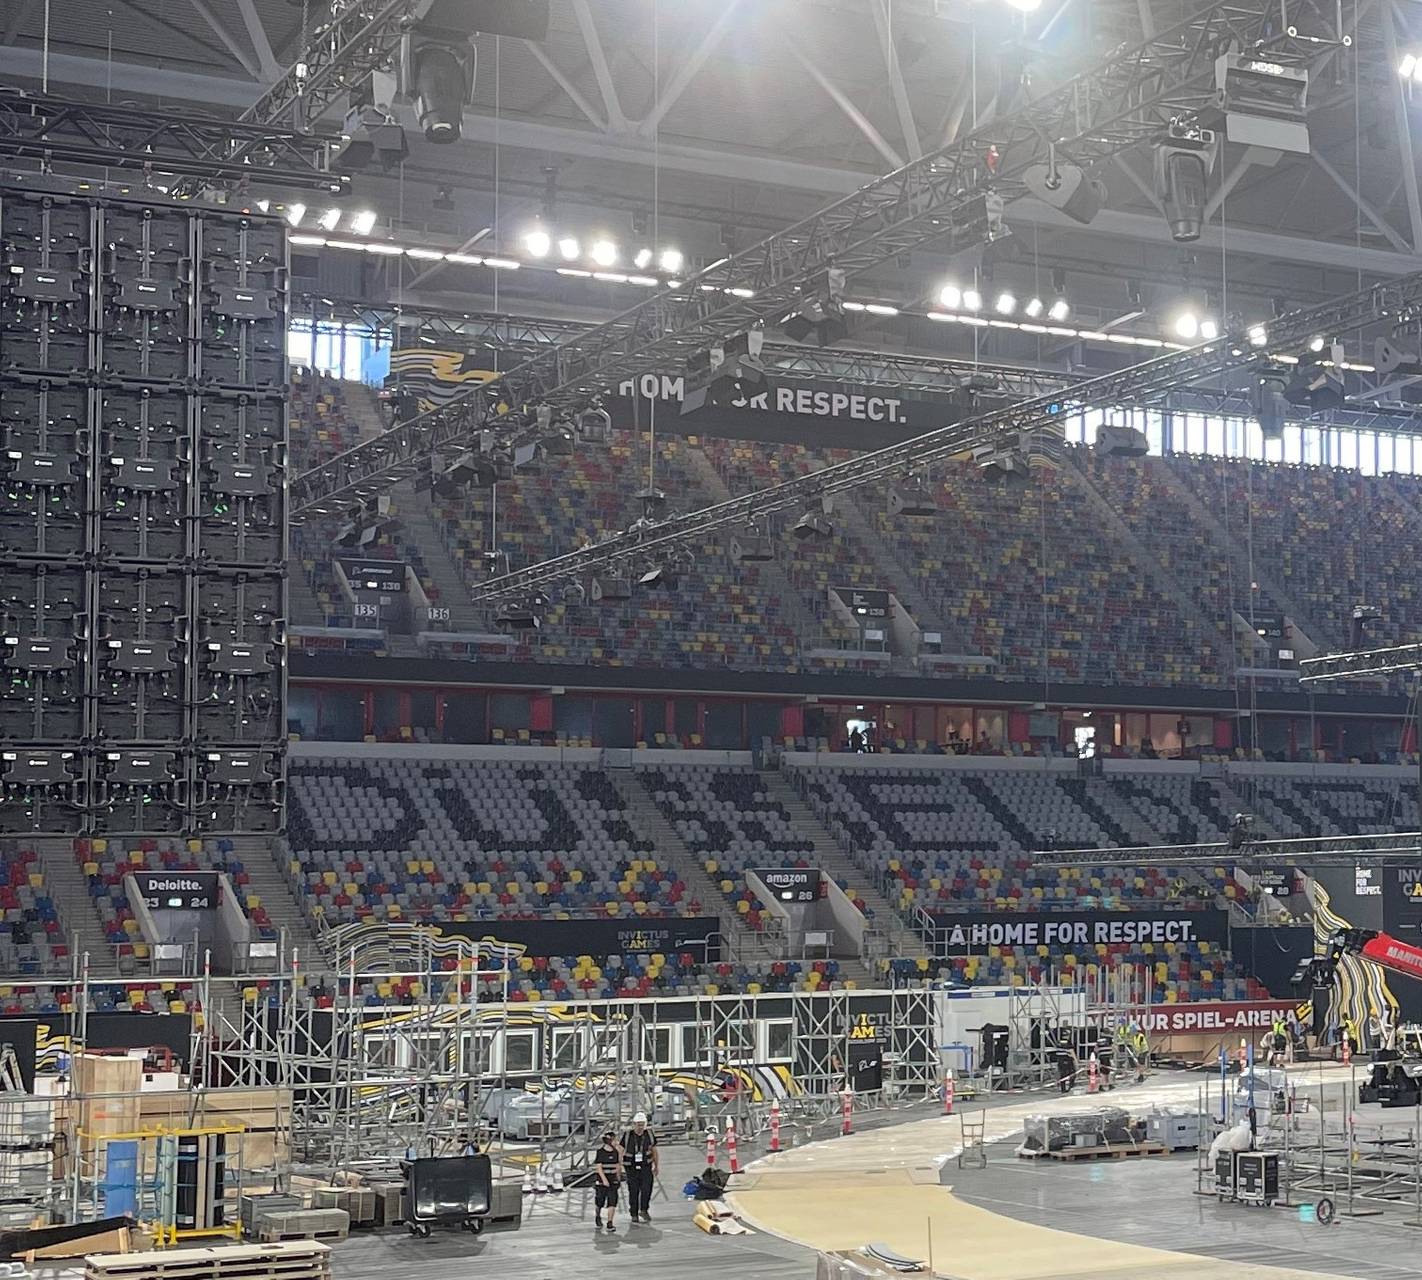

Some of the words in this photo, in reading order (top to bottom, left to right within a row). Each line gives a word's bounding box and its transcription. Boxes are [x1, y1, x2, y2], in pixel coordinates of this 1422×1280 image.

[777, 386, 907, 424] RESPECT.
[356, 604, 377, 616] 135
[429, 608, 450, 620] 136
[766, 873, 807, 883] amazon
[149, 879, 203, 891] Deloitte.
[190, 897, 208, 908] 24
[617, 930, 669, 940] INVICTUS
[950, 924, 966, 945] A
[972, 922, 1038, 944] HOME
[1044, 922, 1088, 944] FOR
[1094, 920, 1197, 943] RESPECT.
[621, 939, 660, 949] GAMES
[1172, 1009, 1297, 1029] SPIEL-ARENA
